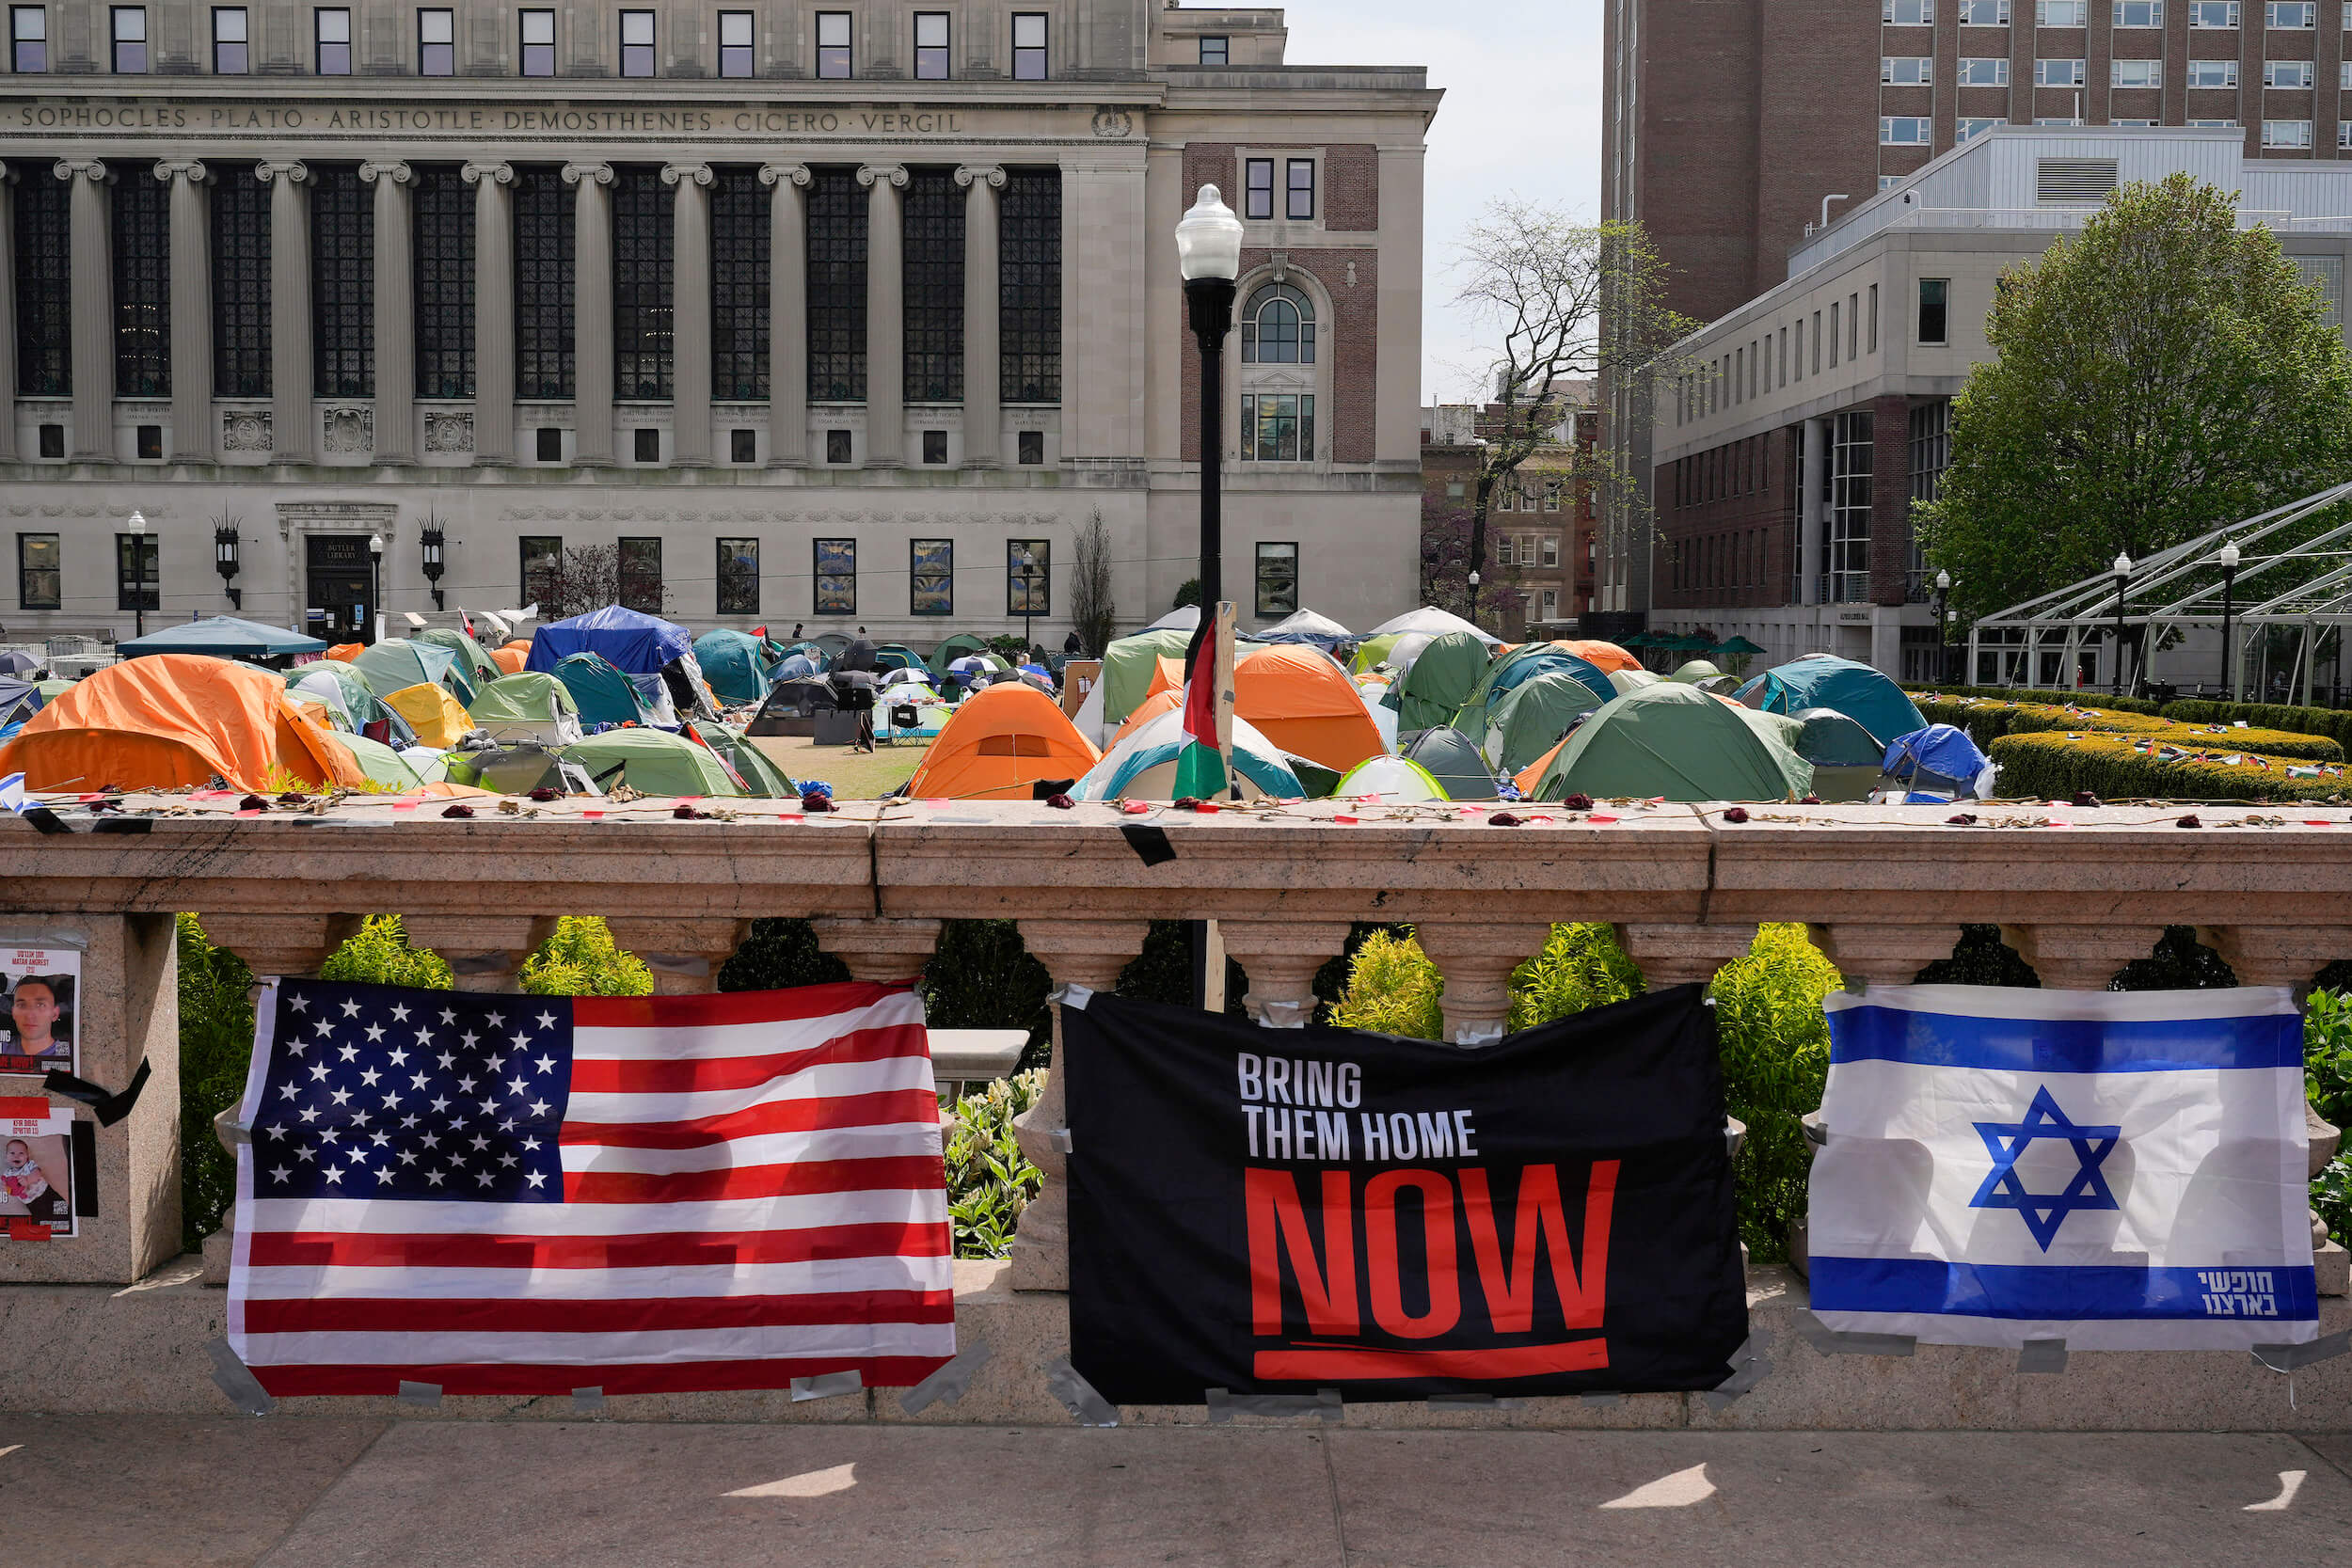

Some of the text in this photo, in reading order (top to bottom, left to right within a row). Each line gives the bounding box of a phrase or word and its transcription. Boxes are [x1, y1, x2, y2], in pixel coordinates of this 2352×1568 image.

[21, 106, 962, 134] SOPHOCLES PLATO ARISTOTLE DEMOSTHENES CICERO VERGIL
[1238, 1052, 1361, 1109] BRING
[1241, 1104, 1479, 1162] THEM HOME
[1245, 1159, 1621, 1339] NOW
[2197, 1271, 2275, 1293] חופשי
[2201, 1293, 2279, 1317] בארצנו
